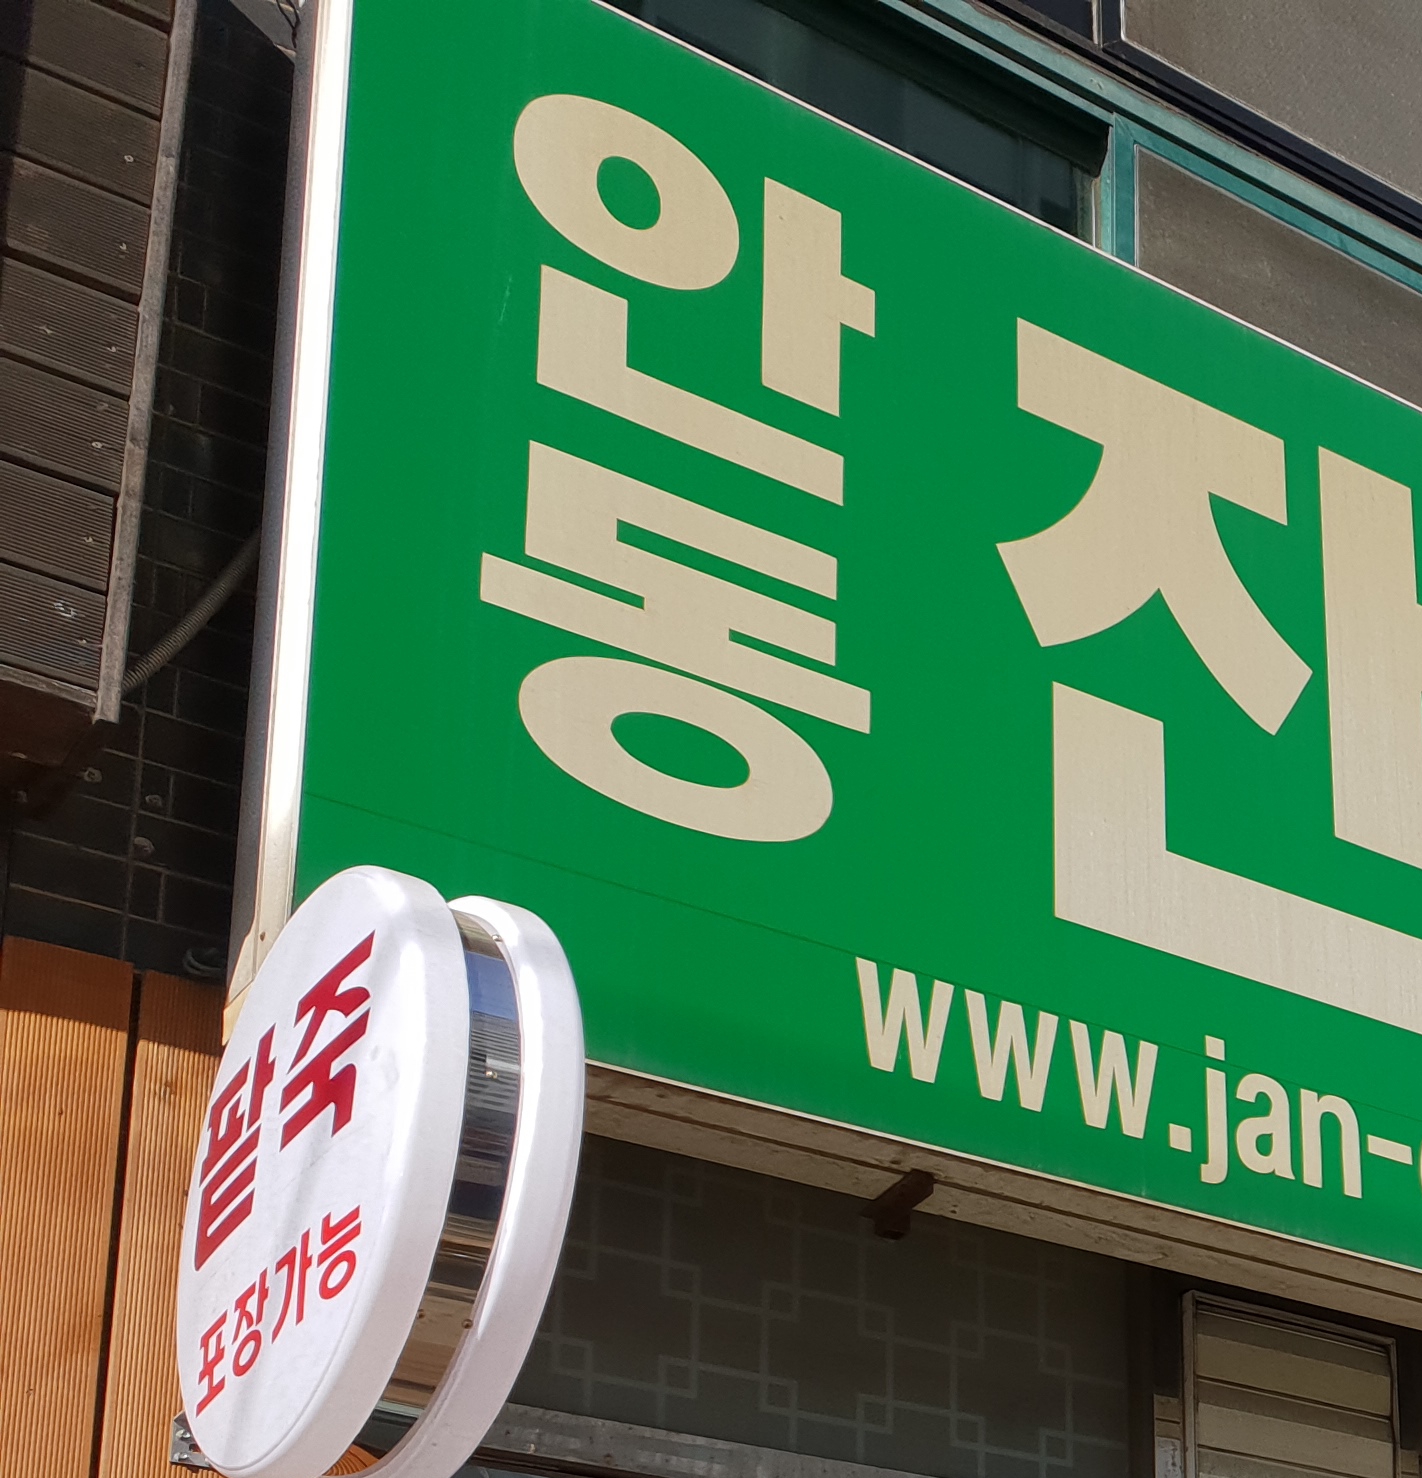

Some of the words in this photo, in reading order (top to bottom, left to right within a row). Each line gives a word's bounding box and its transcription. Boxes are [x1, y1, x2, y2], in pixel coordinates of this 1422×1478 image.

[480, 94, 875, 842] 안동
[194, 931, 376, 1272] 팥죽
[195, 1205, 362, 1414] 포장가능
